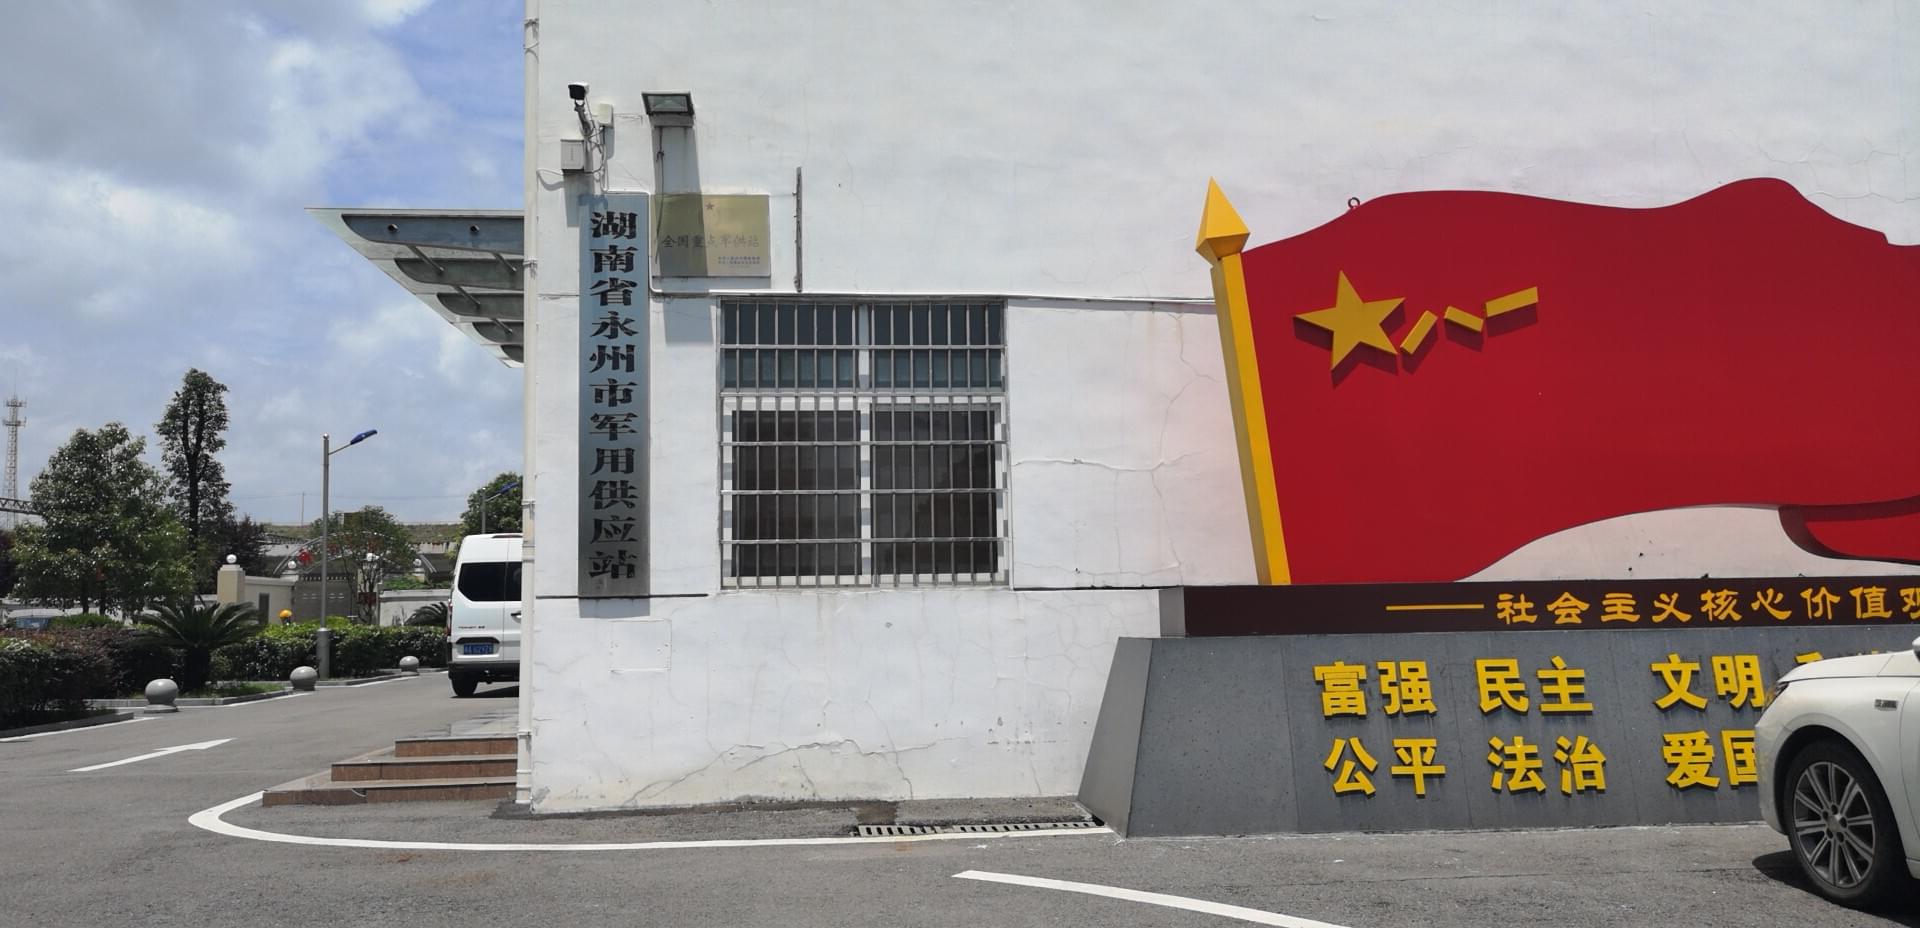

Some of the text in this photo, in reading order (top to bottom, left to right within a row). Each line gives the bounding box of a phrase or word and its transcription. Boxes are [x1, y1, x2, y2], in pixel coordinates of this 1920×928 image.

[662, 234, 760, 249] 全国重点军供站
[588, 210, 638, 579] 湖南省永州市军用供应站
[1313, 652, 1766, 717] 富强 民主 文明
[1324, 729, 1760, 796] 公平 法治 爱国
